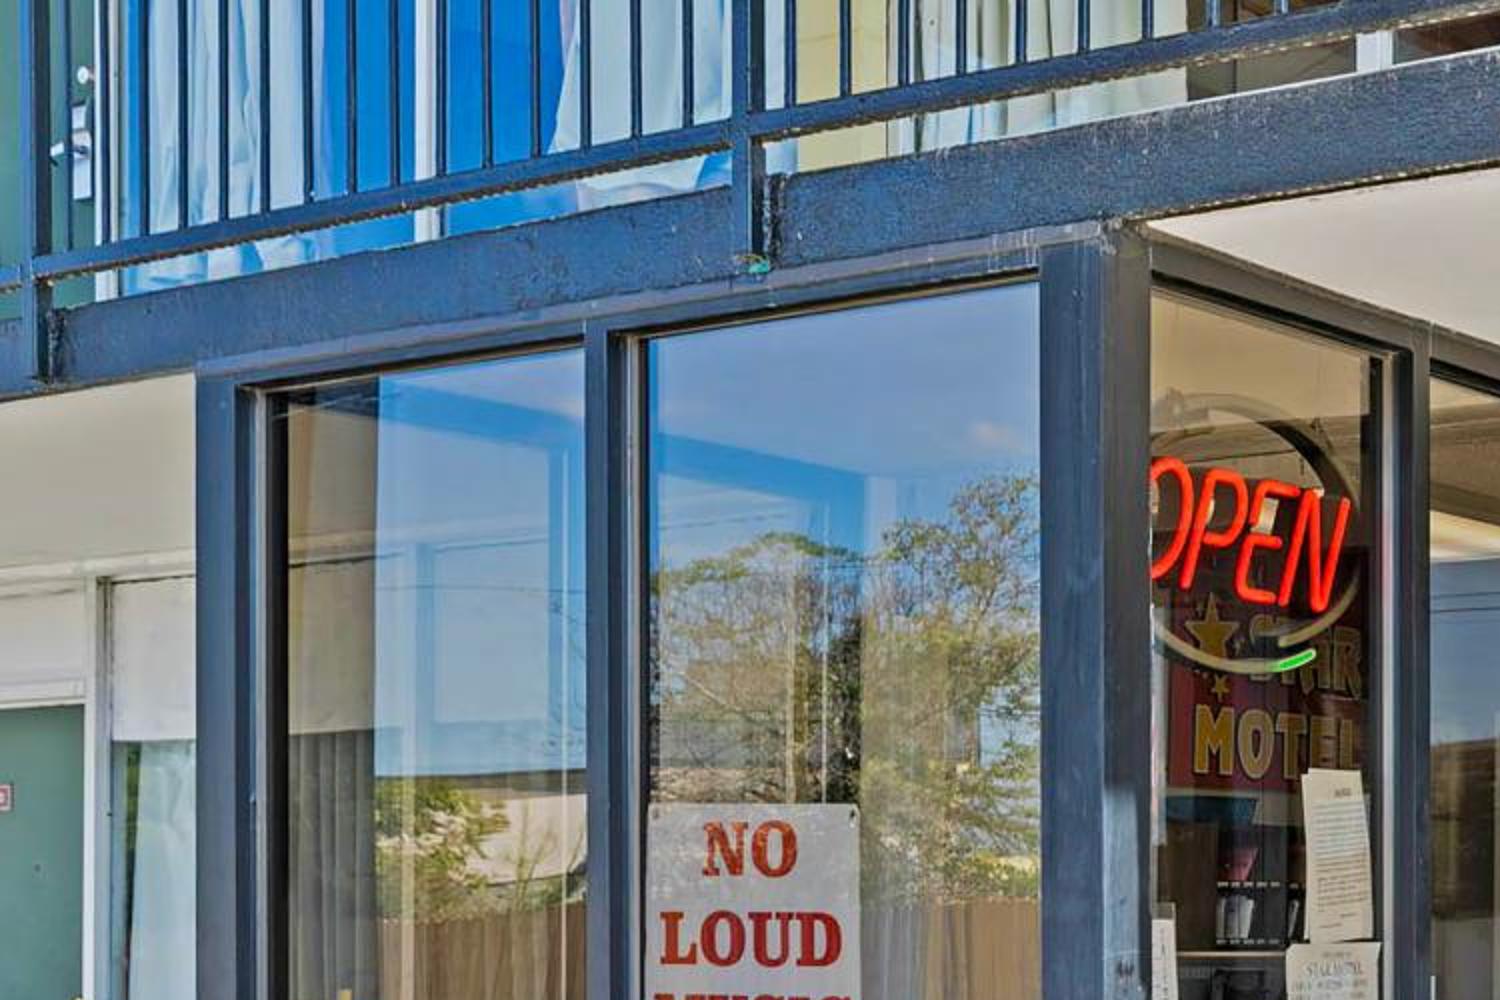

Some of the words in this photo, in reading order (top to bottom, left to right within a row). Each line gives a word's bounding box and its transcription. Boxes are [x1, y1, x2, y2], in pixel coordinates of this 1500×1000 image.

[1150, 457, 1350, 612] OPEN
[702, 819, 798, 878] NO
[659, 910, 842, 968] LOUD
